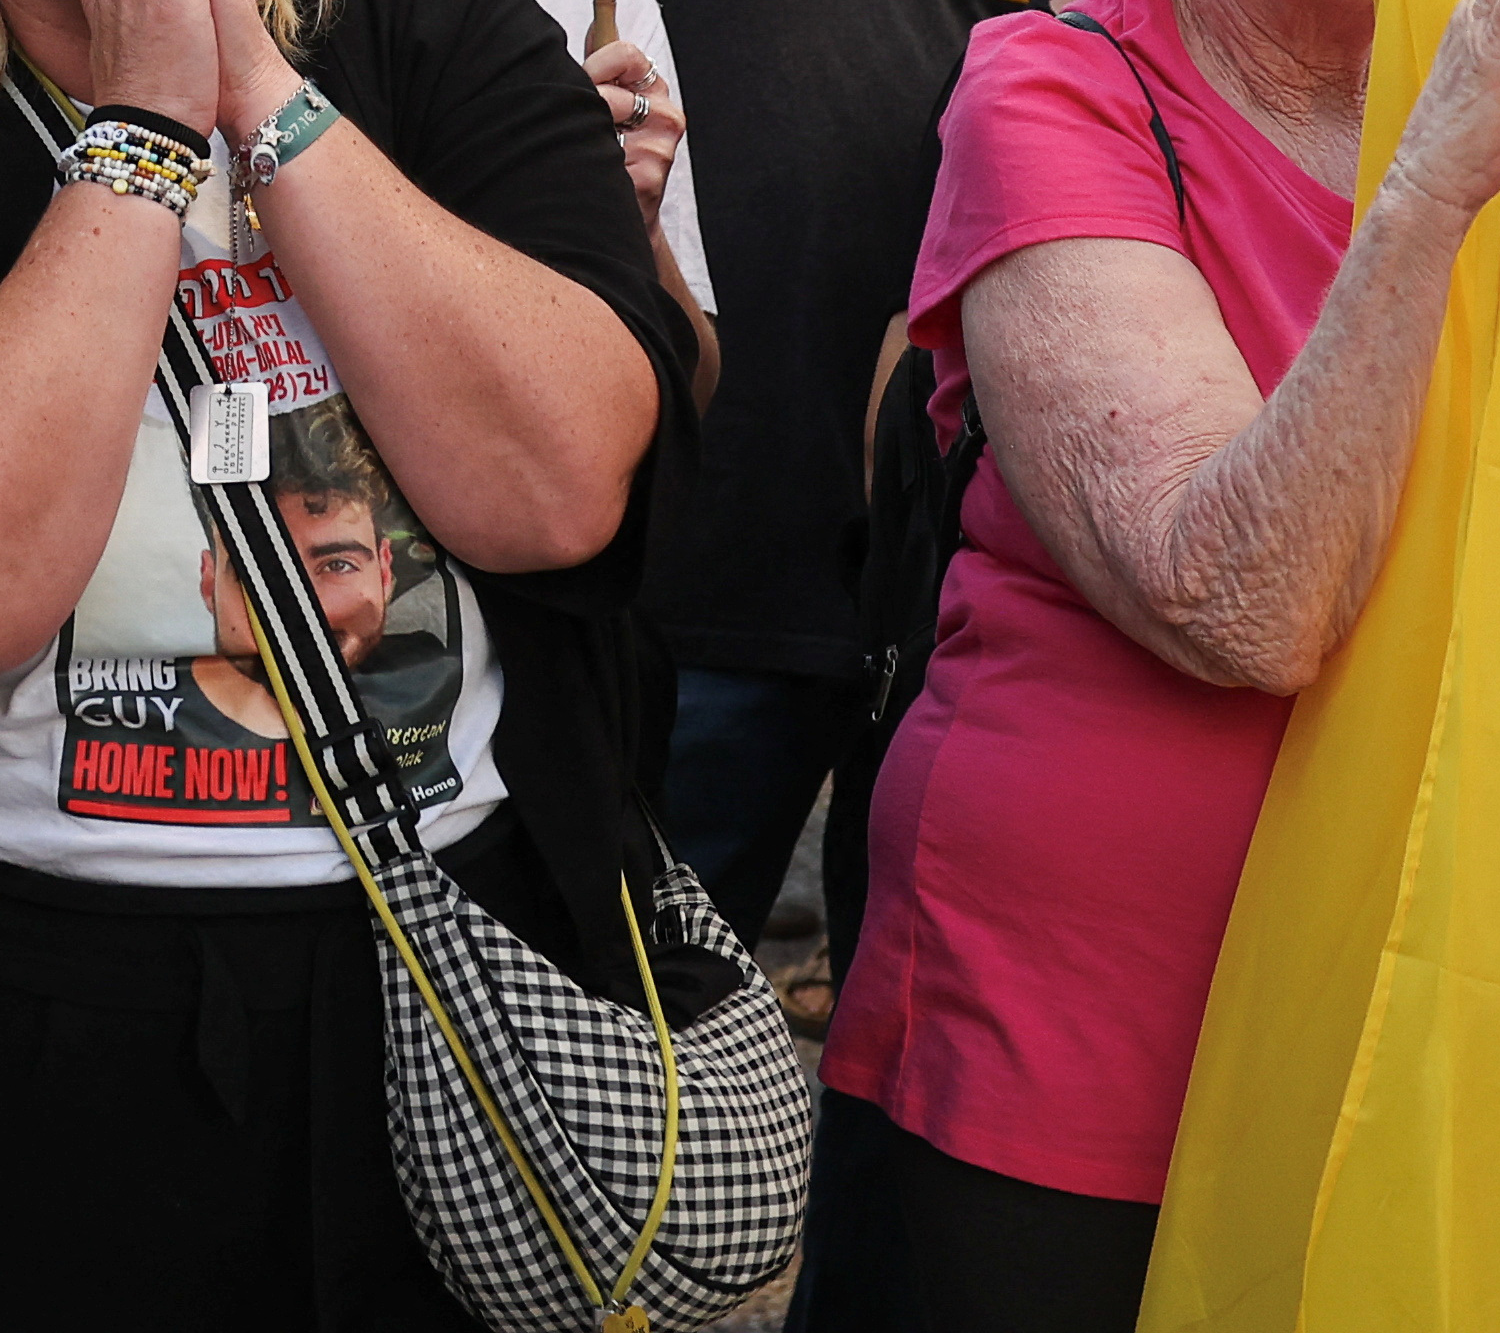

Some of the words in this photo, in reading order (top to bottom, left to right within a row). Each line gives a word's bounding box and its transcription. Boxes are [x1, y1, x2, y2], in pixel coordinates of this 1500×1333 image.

[72, 655, 178, 692] BRING
[75, 695, 185, 733] GUY
[72, 739, 176, 799] HOME
[184, 742, 289, 802] NOW!
